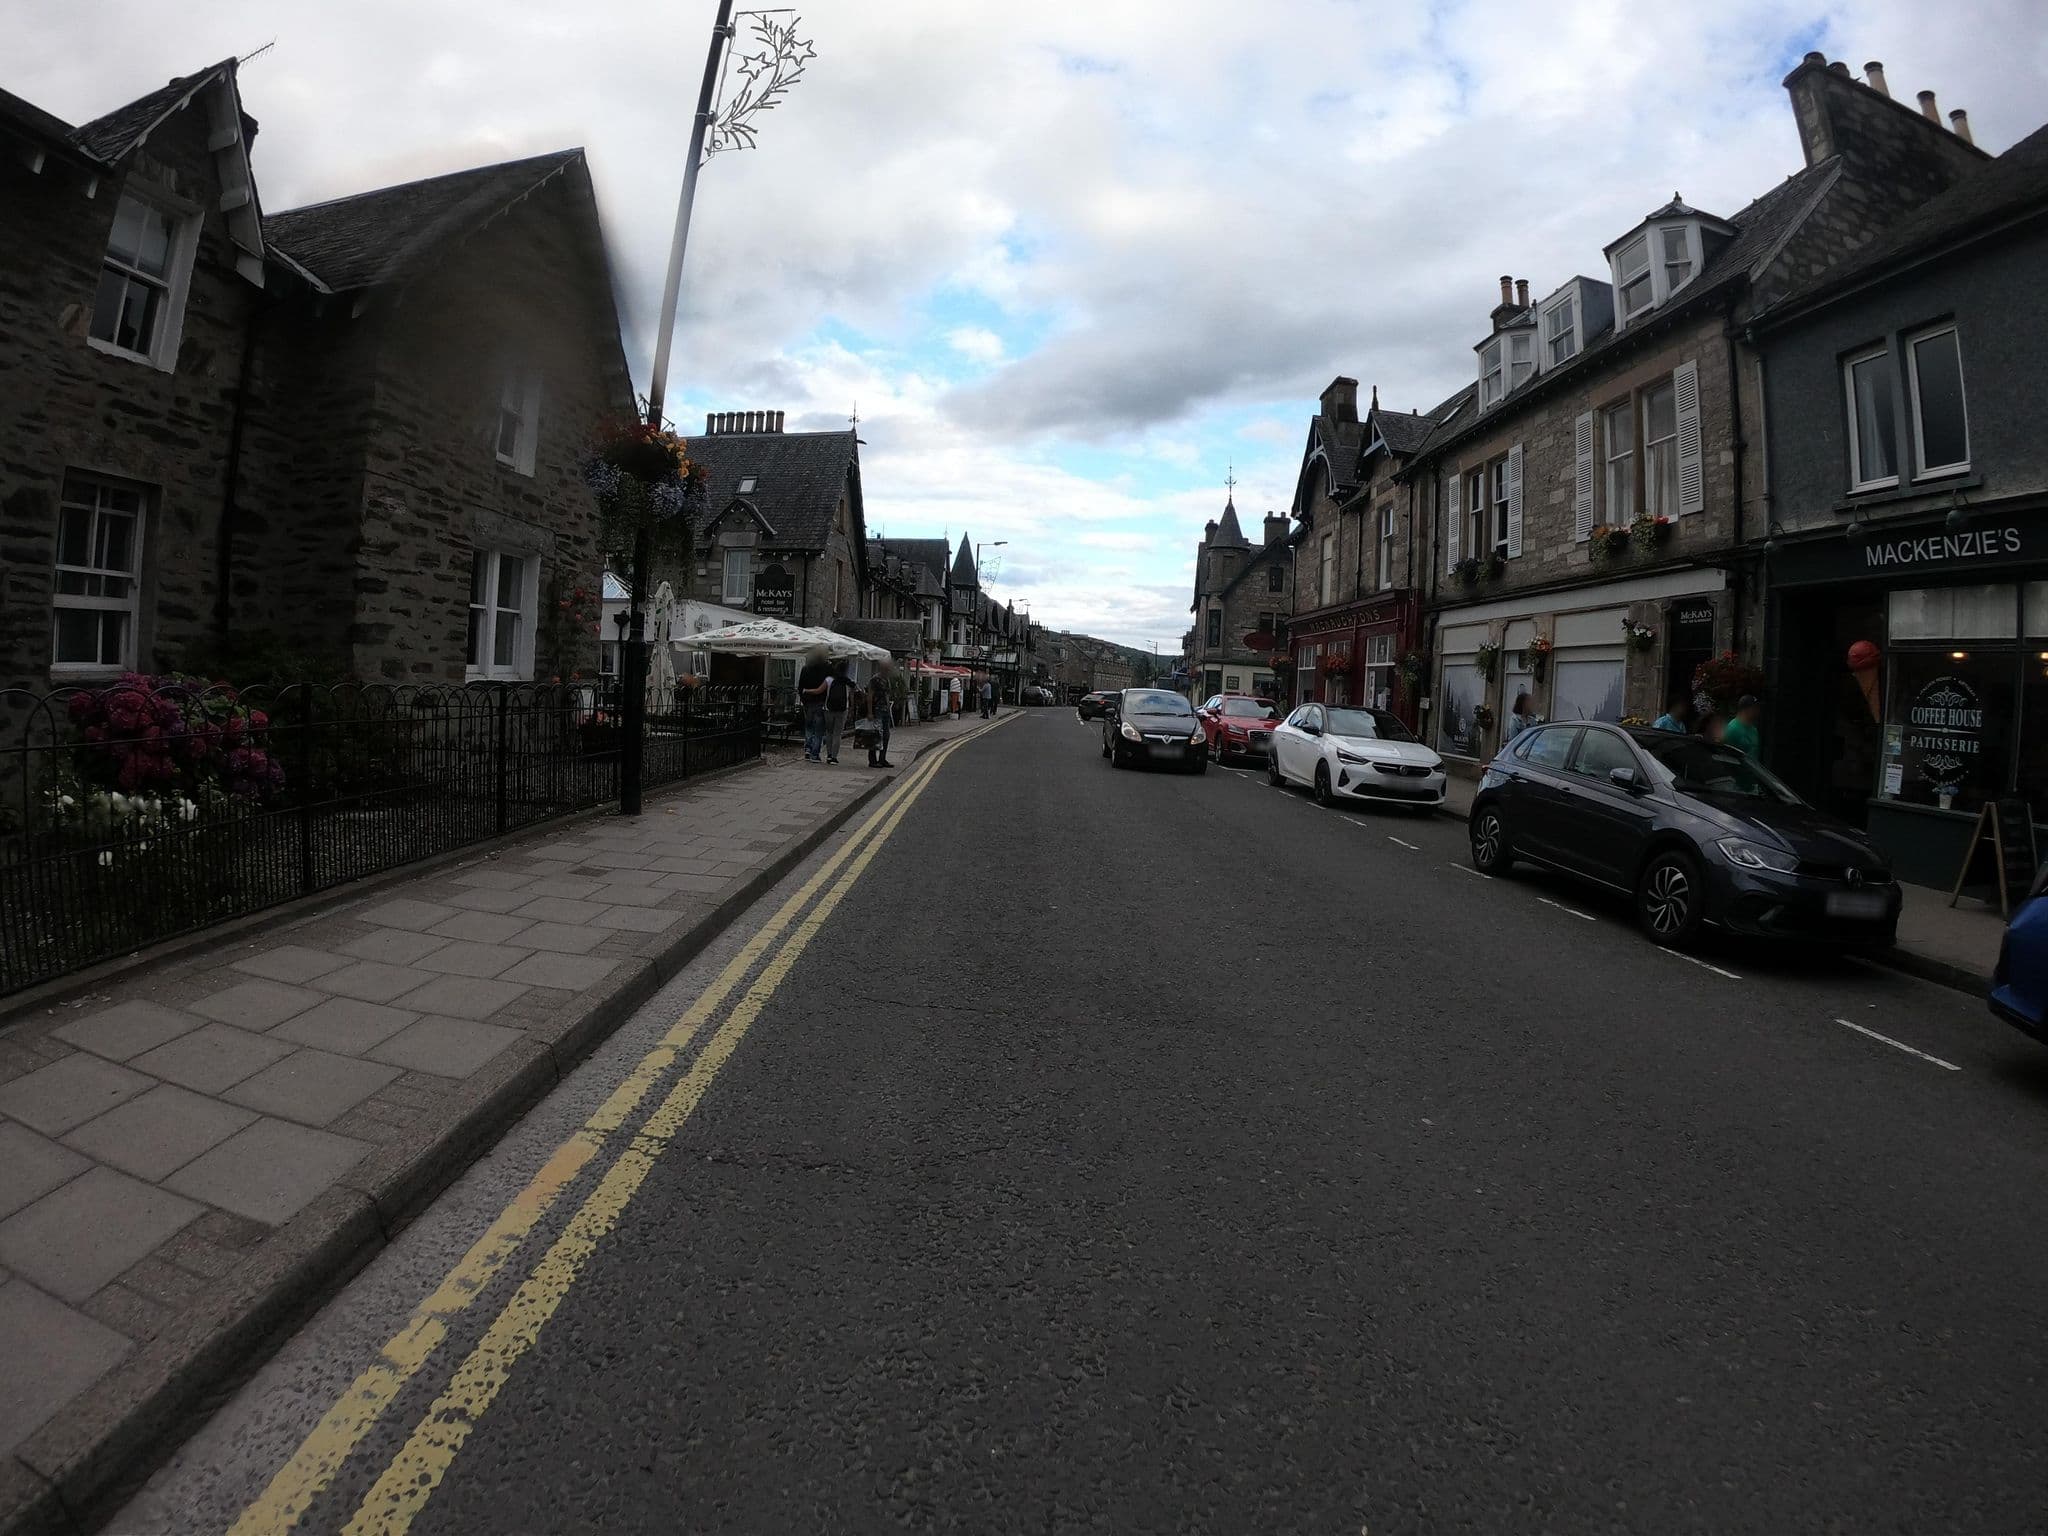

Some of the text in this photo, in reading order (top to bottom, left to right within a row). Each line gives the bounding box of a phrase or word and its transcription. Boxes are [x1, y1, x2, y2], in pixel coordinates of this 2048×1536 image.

[1865, 527, 2021, 567] MACKENZIE'S
[756, 589, 792, 598] McKAYS
[1680, 609, 1712, 619] McKAYS
[1911, 706, 1983, 728] COFFEE HOUSE
[1909, 735, 1981, 753] PATISSERIE
